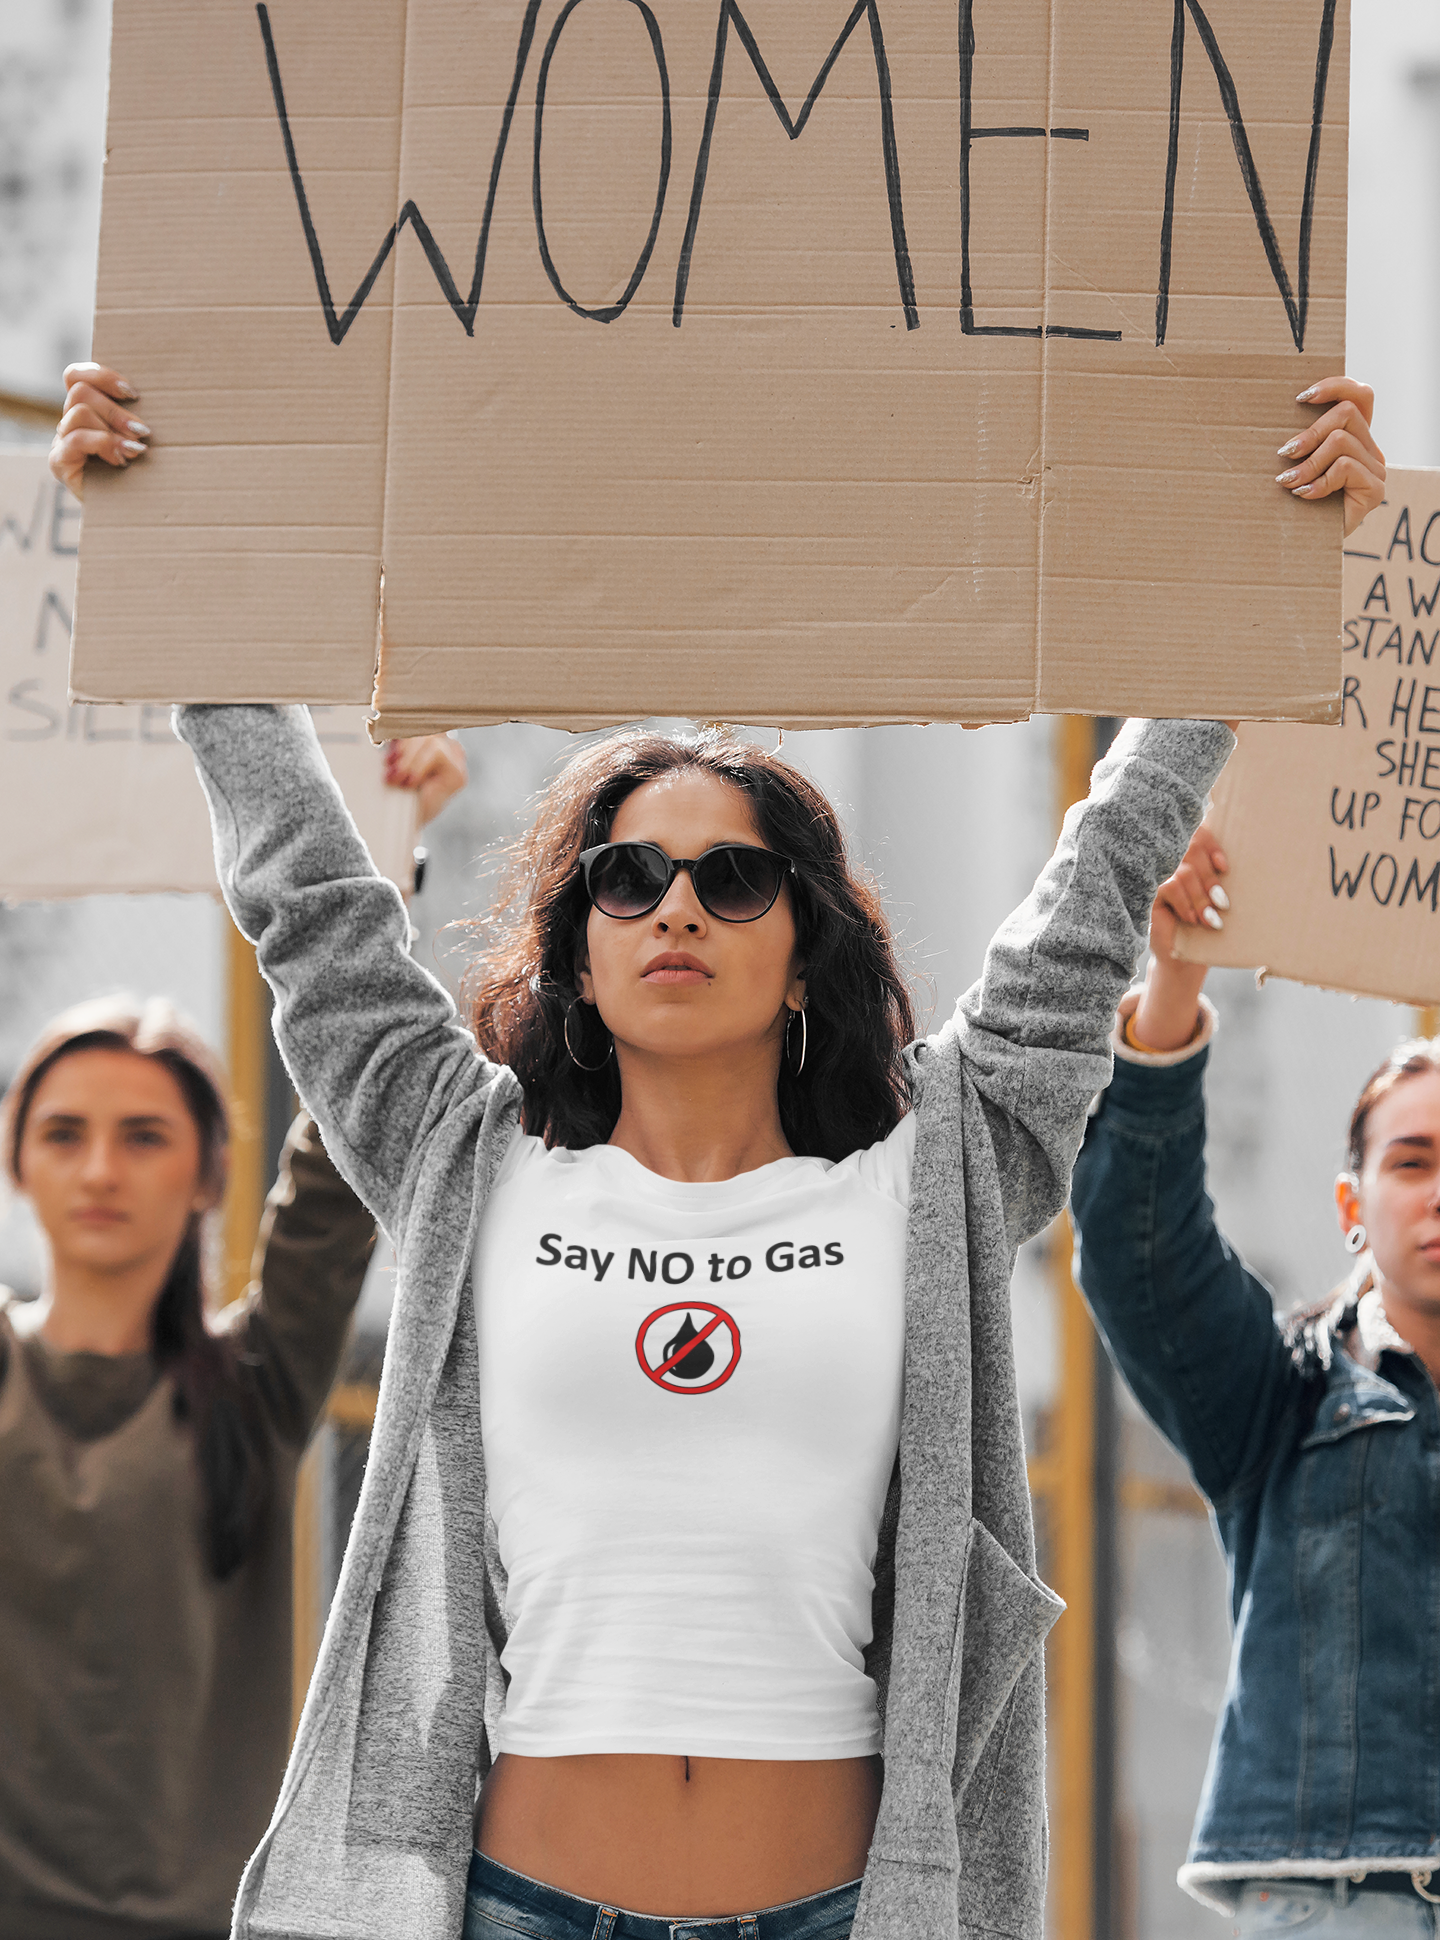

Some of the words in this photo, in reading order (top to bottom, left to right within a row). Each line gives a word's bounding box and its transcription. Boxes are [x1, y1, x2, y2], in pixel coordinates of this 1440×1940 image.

[256, 0, 1337, 353] WOMEN
[1363, 573, 1390, 613] A
[1331, 787, 1380, 830] UP
[535, 1233, 615, 1283] Say
[627, 1247, 695, 1285] NO
[707, 1252, 752, 1283] to
[765, 1241, 845, 1273] Gas
